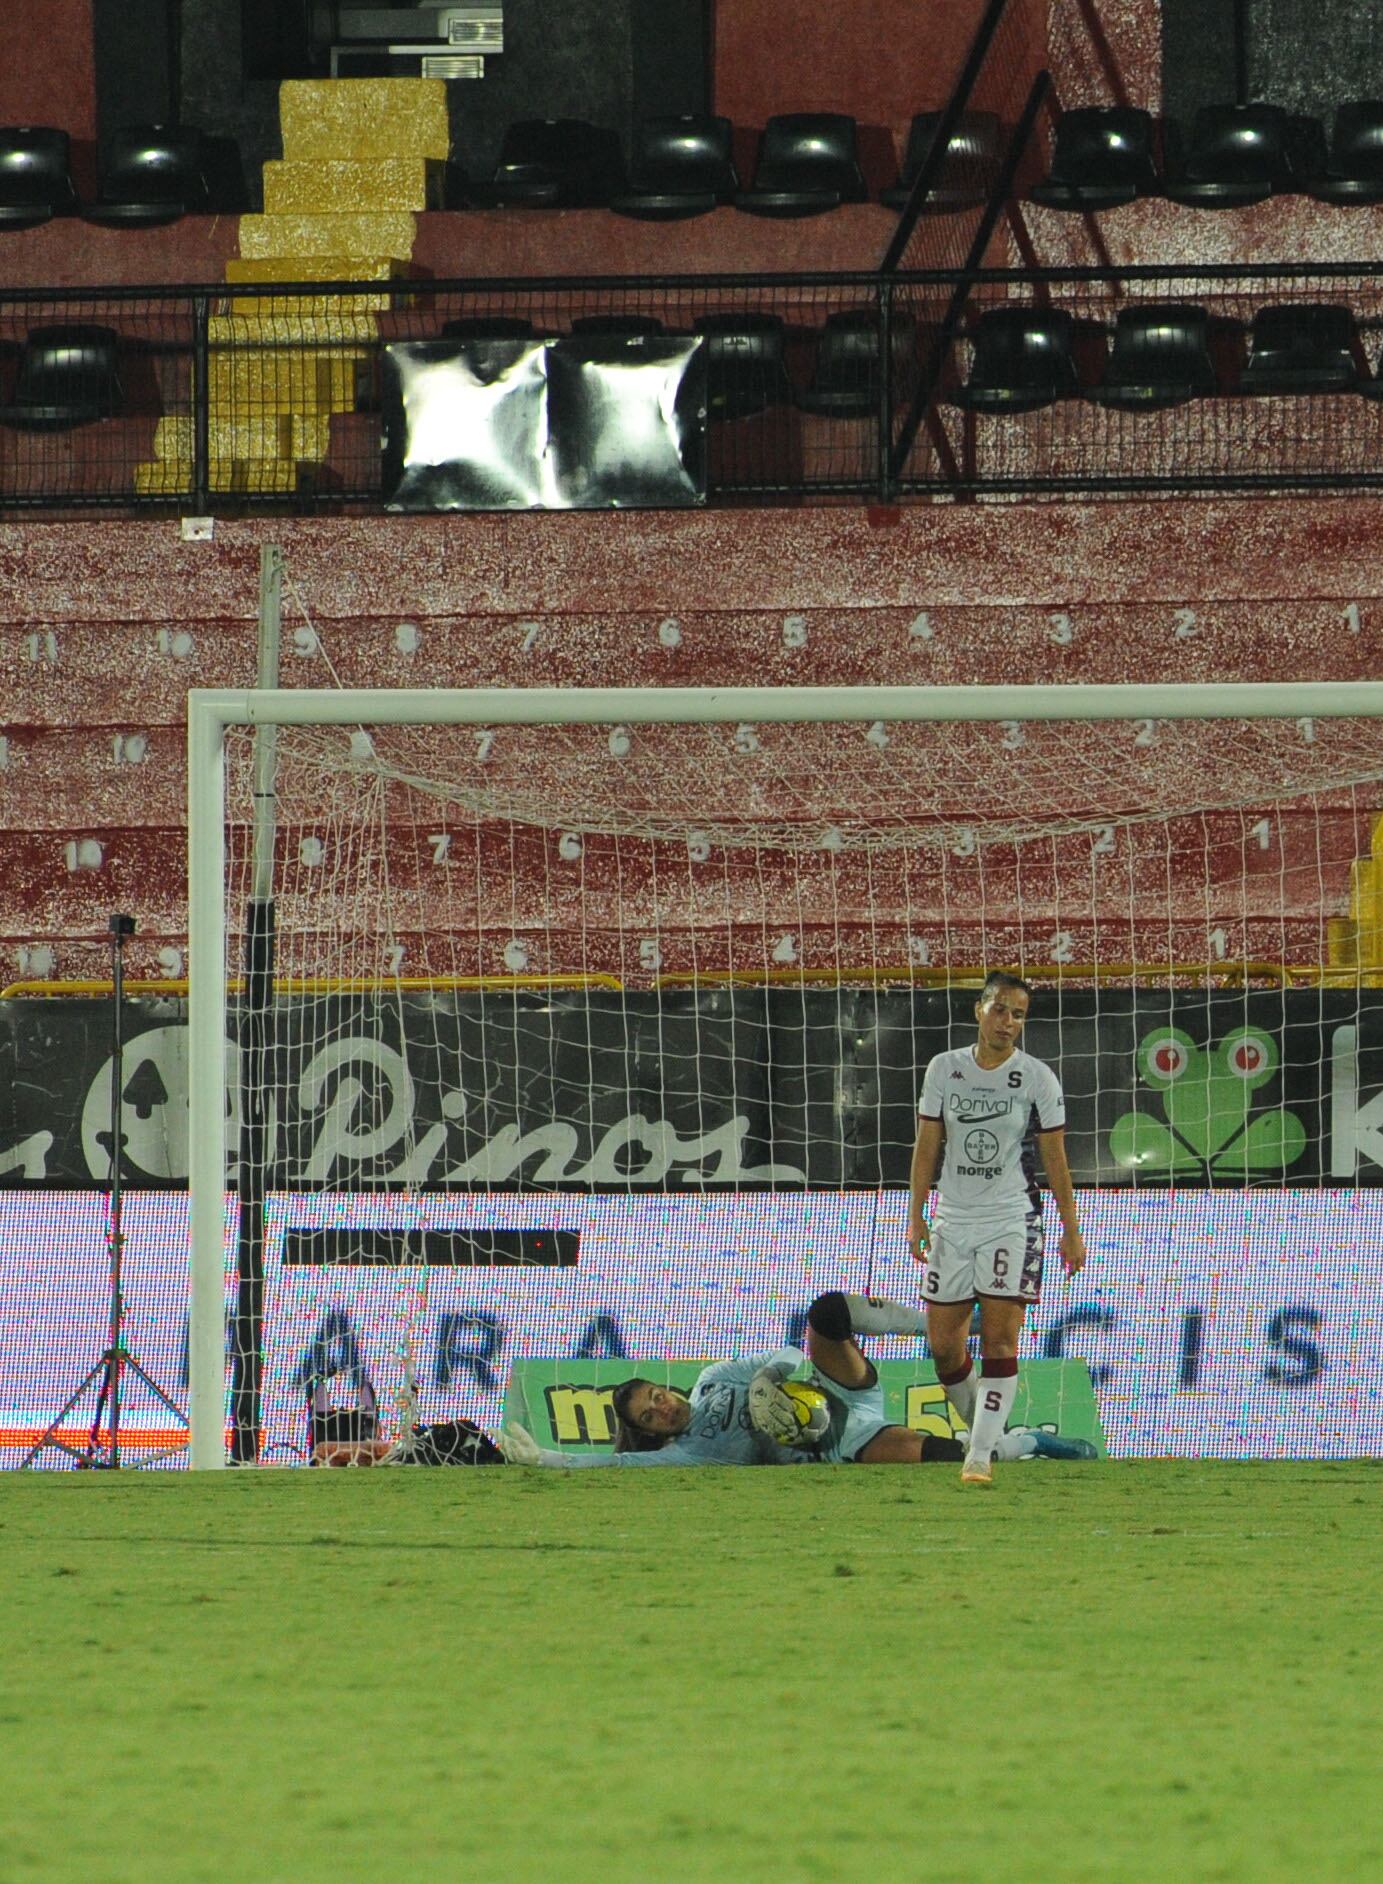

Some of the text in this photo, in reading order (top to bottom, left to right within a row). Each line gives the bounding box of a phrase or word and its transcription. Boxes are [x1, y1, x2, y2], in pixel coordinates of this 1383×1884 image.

[658, 617, 683, 648] 6
[782, 614, 808, 648] 5
[908, 611, 934, 640] 4
[1048, 613, 1074, 645] 3
[1174, 607, 1199, 638] 2
[1341, 603, 1361, 634] 1
[514, 621, 542, 650] 7
[473, 730, 495, 761] 7
[608, 726, 632, 757] 6
[1000, 719, 1025, 749] 3
[1133, 718, 1156, 747] 2
[559, 831, 582, 861] 6
[1093, 825, 1117, 853] 2
[1249, 817, 1272, 849] 1
[428, 835, 452, 864] 7
[639, 939, 663, 970] 5
[772, 933, 797, 963] 4
[1050, 931, 1075, 962] 2
[1209, 927, 1228, 958] 1
[157, 946, 182, 978] 9
[1007, 1070, 1023, 1089] S
[288, 1037, 806, 1182] Pinos
[950, 1092, 1013, 1114] Dorival
[957, 1164, 1003, 1180] monge
[992, 1247, 1010, 1277] 6
[926, 1271, 940, 1295] S
[984, 1390, 1002, 1412] S
